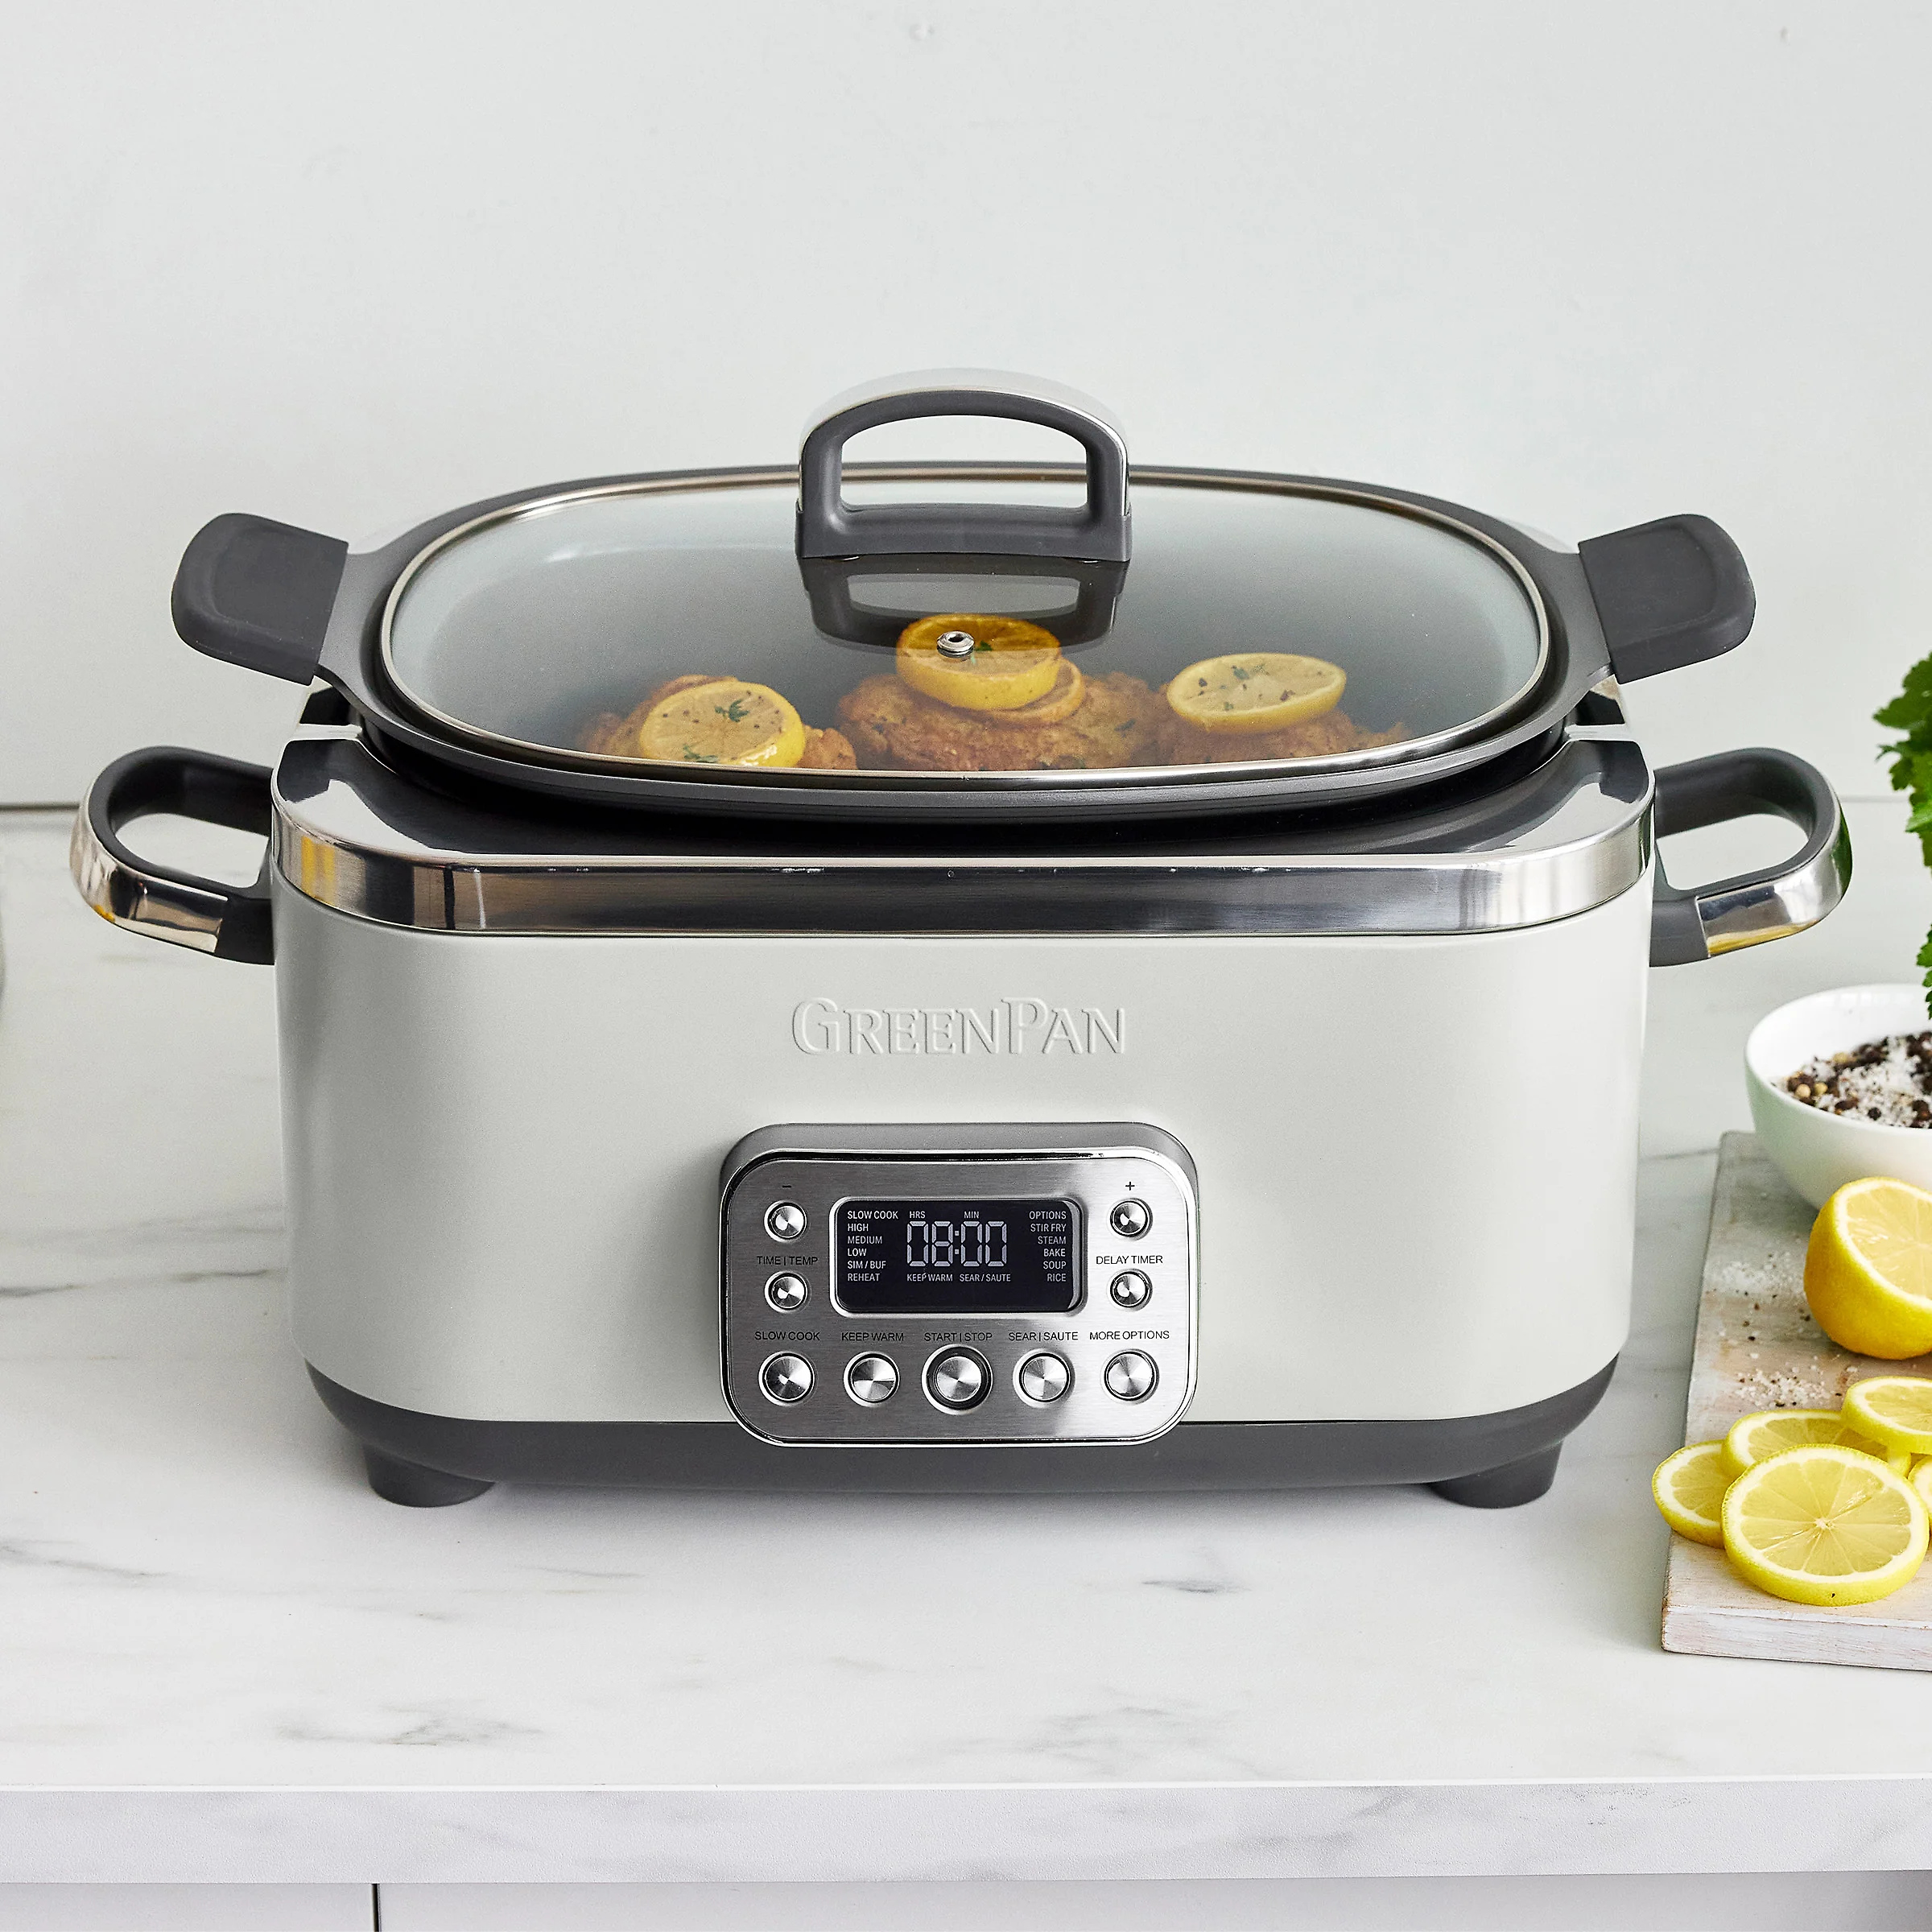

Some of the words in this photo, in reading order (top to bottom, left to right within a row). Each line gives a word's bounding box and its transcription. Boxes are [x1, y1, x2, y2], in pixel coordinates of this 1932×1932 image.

[847, 1210, 873, 1220] SLOW
[873, 1210, 899, 1220] COOK
[909, 1210, 926, 1220] HRS
[964, 1210, 980, 1220] MIN
[1029, 1210, 1067, 1220] OPTIONS
[847, 1223, 869, 1232] HIGH
[1030, 1223, 1050, 1232] STIR
[1050, 1223, 1067, 1232] FRY
[847, 1235, 883, 1245] MEDIUM
[906, 1220, 1007, 1267] 08:00
[1037, 1235, 1067, 1245] STEAM
[847, 1248, 867, 1257] LOW
[1043, 1248, 1066, 1257] BAKE
[756, 1256, 782, 1265] TIME
[788, 1256, 819, 1265] TEMP
[847, 1260, 864, 1269] SIM
[869, 1260, 886, 1269] BUF
[1096, 1255, 1129, 1265] DELAY
[1130, 1254, 1163, 1265] TIMER
[1042, 1260, 1067, 1270] SOUP
[847, 1273, 881, 1282] REHEAT
[906, 1273, 927, 1282] KEEP
[927, 1274, 953, 1282] WARM
[959, 1274, 980, 1282] SEAR
[985, 1273, 1011, 1282] SAUTE
[1046, 1273, 1067, 1282] RICE
[754, 1331, 786, 1341] SLOW
[787, 1331, 820, 1341] COOK
[841, 1331, 870, 1342] KEEP
[871, 1331, 904, 1342] WARM
[923, 1332, 958, 1342] START
[964, 1331, 993, 1342] STOP
[1008, 1331, 1037, 1341] SEAR
[1043, 1331, 1079, 1342] SAUTE
[1089, 1331, 1121, 1340] MORE
[1122, 1330, 1170, 1340] OPTIONS
